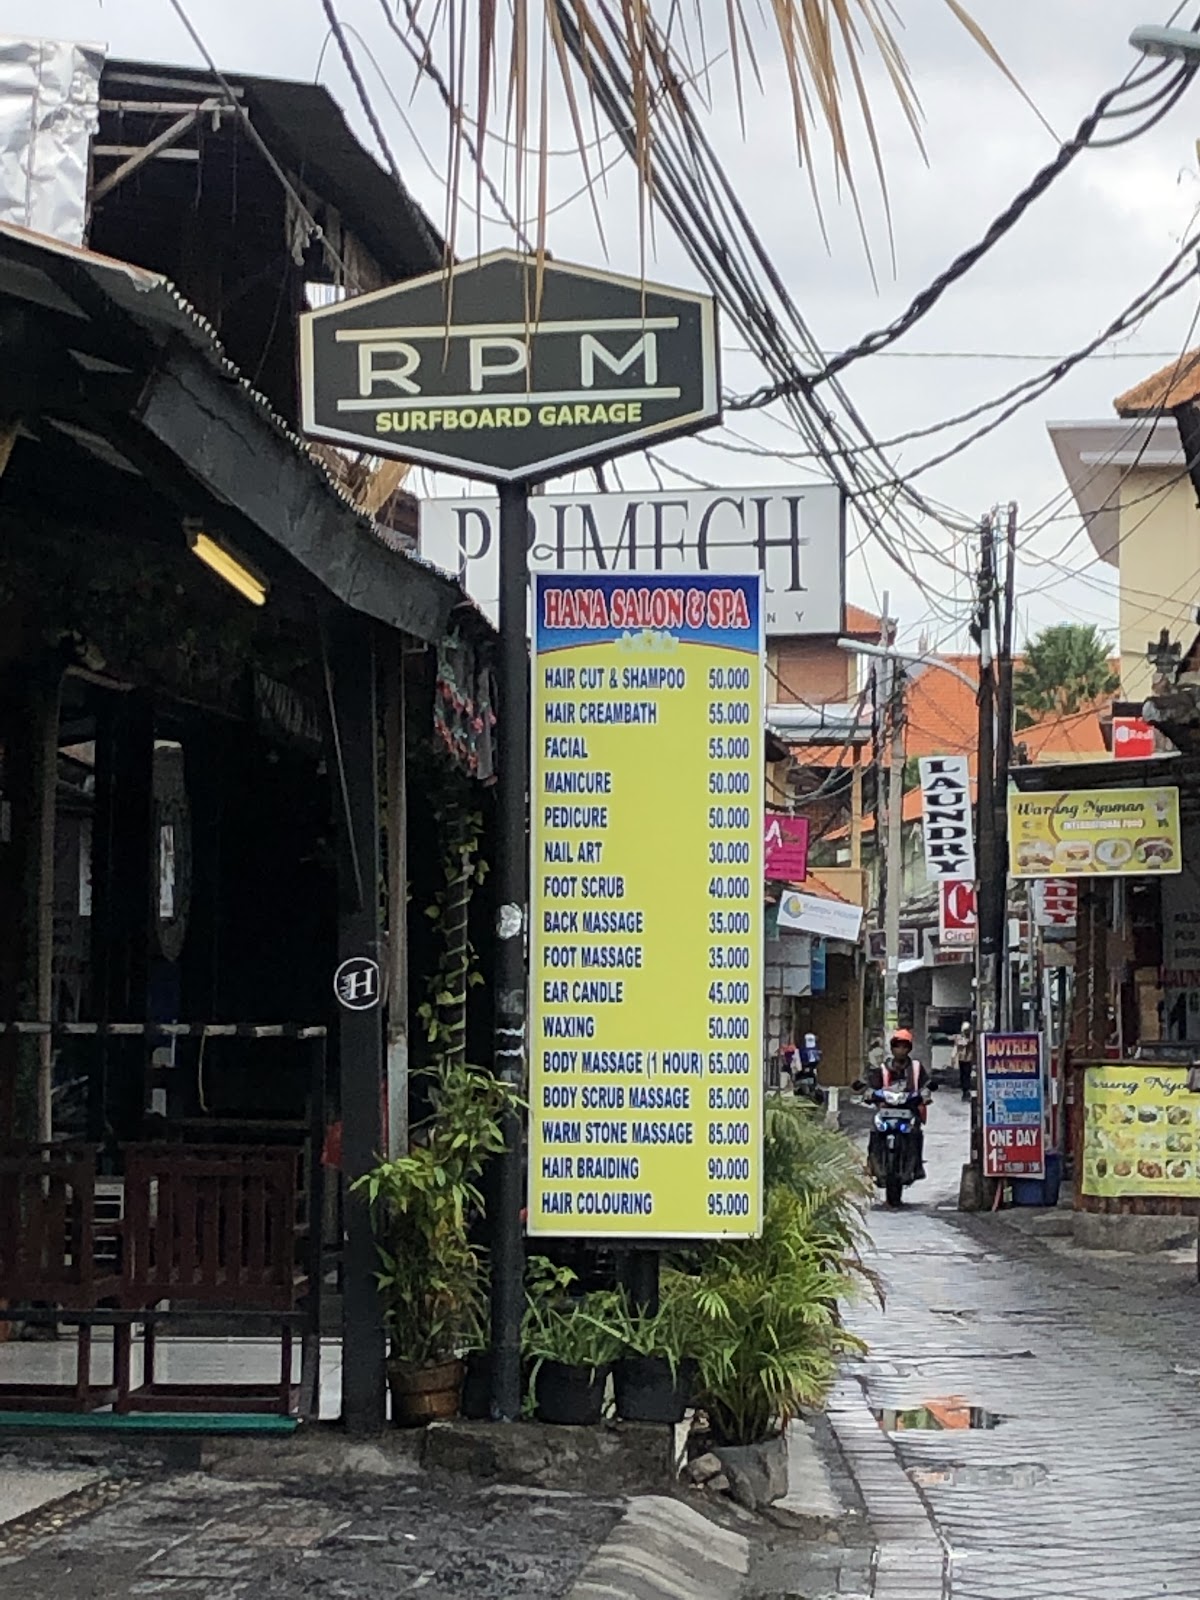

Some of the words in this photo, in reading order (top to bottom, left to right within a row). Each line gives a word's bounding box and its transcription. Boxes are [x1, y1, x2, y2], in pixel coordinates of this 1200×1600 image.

[376, 406, 531, 433] SURFBOARD
[538, 402, 643, 427] GARAGE
[544, 589, 608, 628] HANA
[611, 588, 683, 628] SALON
[687, 589, 705, 628] &
[708, 588, 750, 628] SPA
[544, 668, 576, 689] HAIR
[579, 668, 605, 689] CUT
[608, 668, 618, 689] &
[622, 668, 685, 689] SHAMPOO
[709, 668, 750, 689] 50.000
[544, 703, 576, 723] HAIR
[579, 703, 657, 723] CREAMBATH
[709, 703, 749, 723] 55.000
[544, 737, 589, 758] FACIAL
[709, 737, 750, 758] 55.000
[544, 772, 612, 793] MANICURE
[709, 772, 750, 793] 50.000
[544, 807, 608, 828] PEDICURE
[709, 807, 750, 828] 50.000
[926, 759, 969, 874] LAUNDRY
[1016, 802, 1079, 818] Warung
[1083, 799, 1145, 818] Nyoman
[543, 842, 574, 863] NAIL
[577, 842, 603, 863] ART
[709, 842, 749, 863] 30.000
[543, 876, 578, 898] FOOT
[581, 876, 624, 898] SCRUB
[708, 876, 750, 898] 40.000
[543, 911, 578, 933] BACK
[582, 911, 643, 933] MASSAGE
[708, 911, 750, 933] 35.000
[543, 947, 578, 968] FOOT
[581, 947, 642, 968] MASSAGE
[708, 947, 749, 968] 35.000
[543, 982, 569, 1003] EAR
[572, 982, 623, 1003] CANDLE
[708, 982, 749, 1003] 45.000
[542, 1017, 594, 1038] WAXING
[708, 1017, 749, 1038] 50.000
[543, 1052, 578, 1073] BODY
[581, 1052, 643, 1073] MASSAGE
[662, 1052, 703, 1079] HOUR)
[708, 1052, 749, 1073] 65.000
[543, 1087, 578, 1108] BODY
[581, 1087, 625, 1108] SCRUB
[628, 1087, 690, 1108] MASSAGE
[708, 1087, 750, 1108] 85.000
[542, 1122, 581, 1144] WARM
[585, 1122, 628, 1144] STONE
[631, 1122, 693, 1144] MASSAGE
[708, 1122, 749, 1144] 85.000
[988, 1129, 1013, 1147] ONE
[1016, 1128, 1039, 1147] DAY
[542, 1157, 574, 1179] HAIR
[576, 1157, 639, 1179] BRAIDING
[708, 1157, 749, 1179] 90.000
[541, 1193, 573, 1215] HAIR
[576, 1193, 652, 1215] COLOURING
[707, 1193, 749, 1215] 95.000
